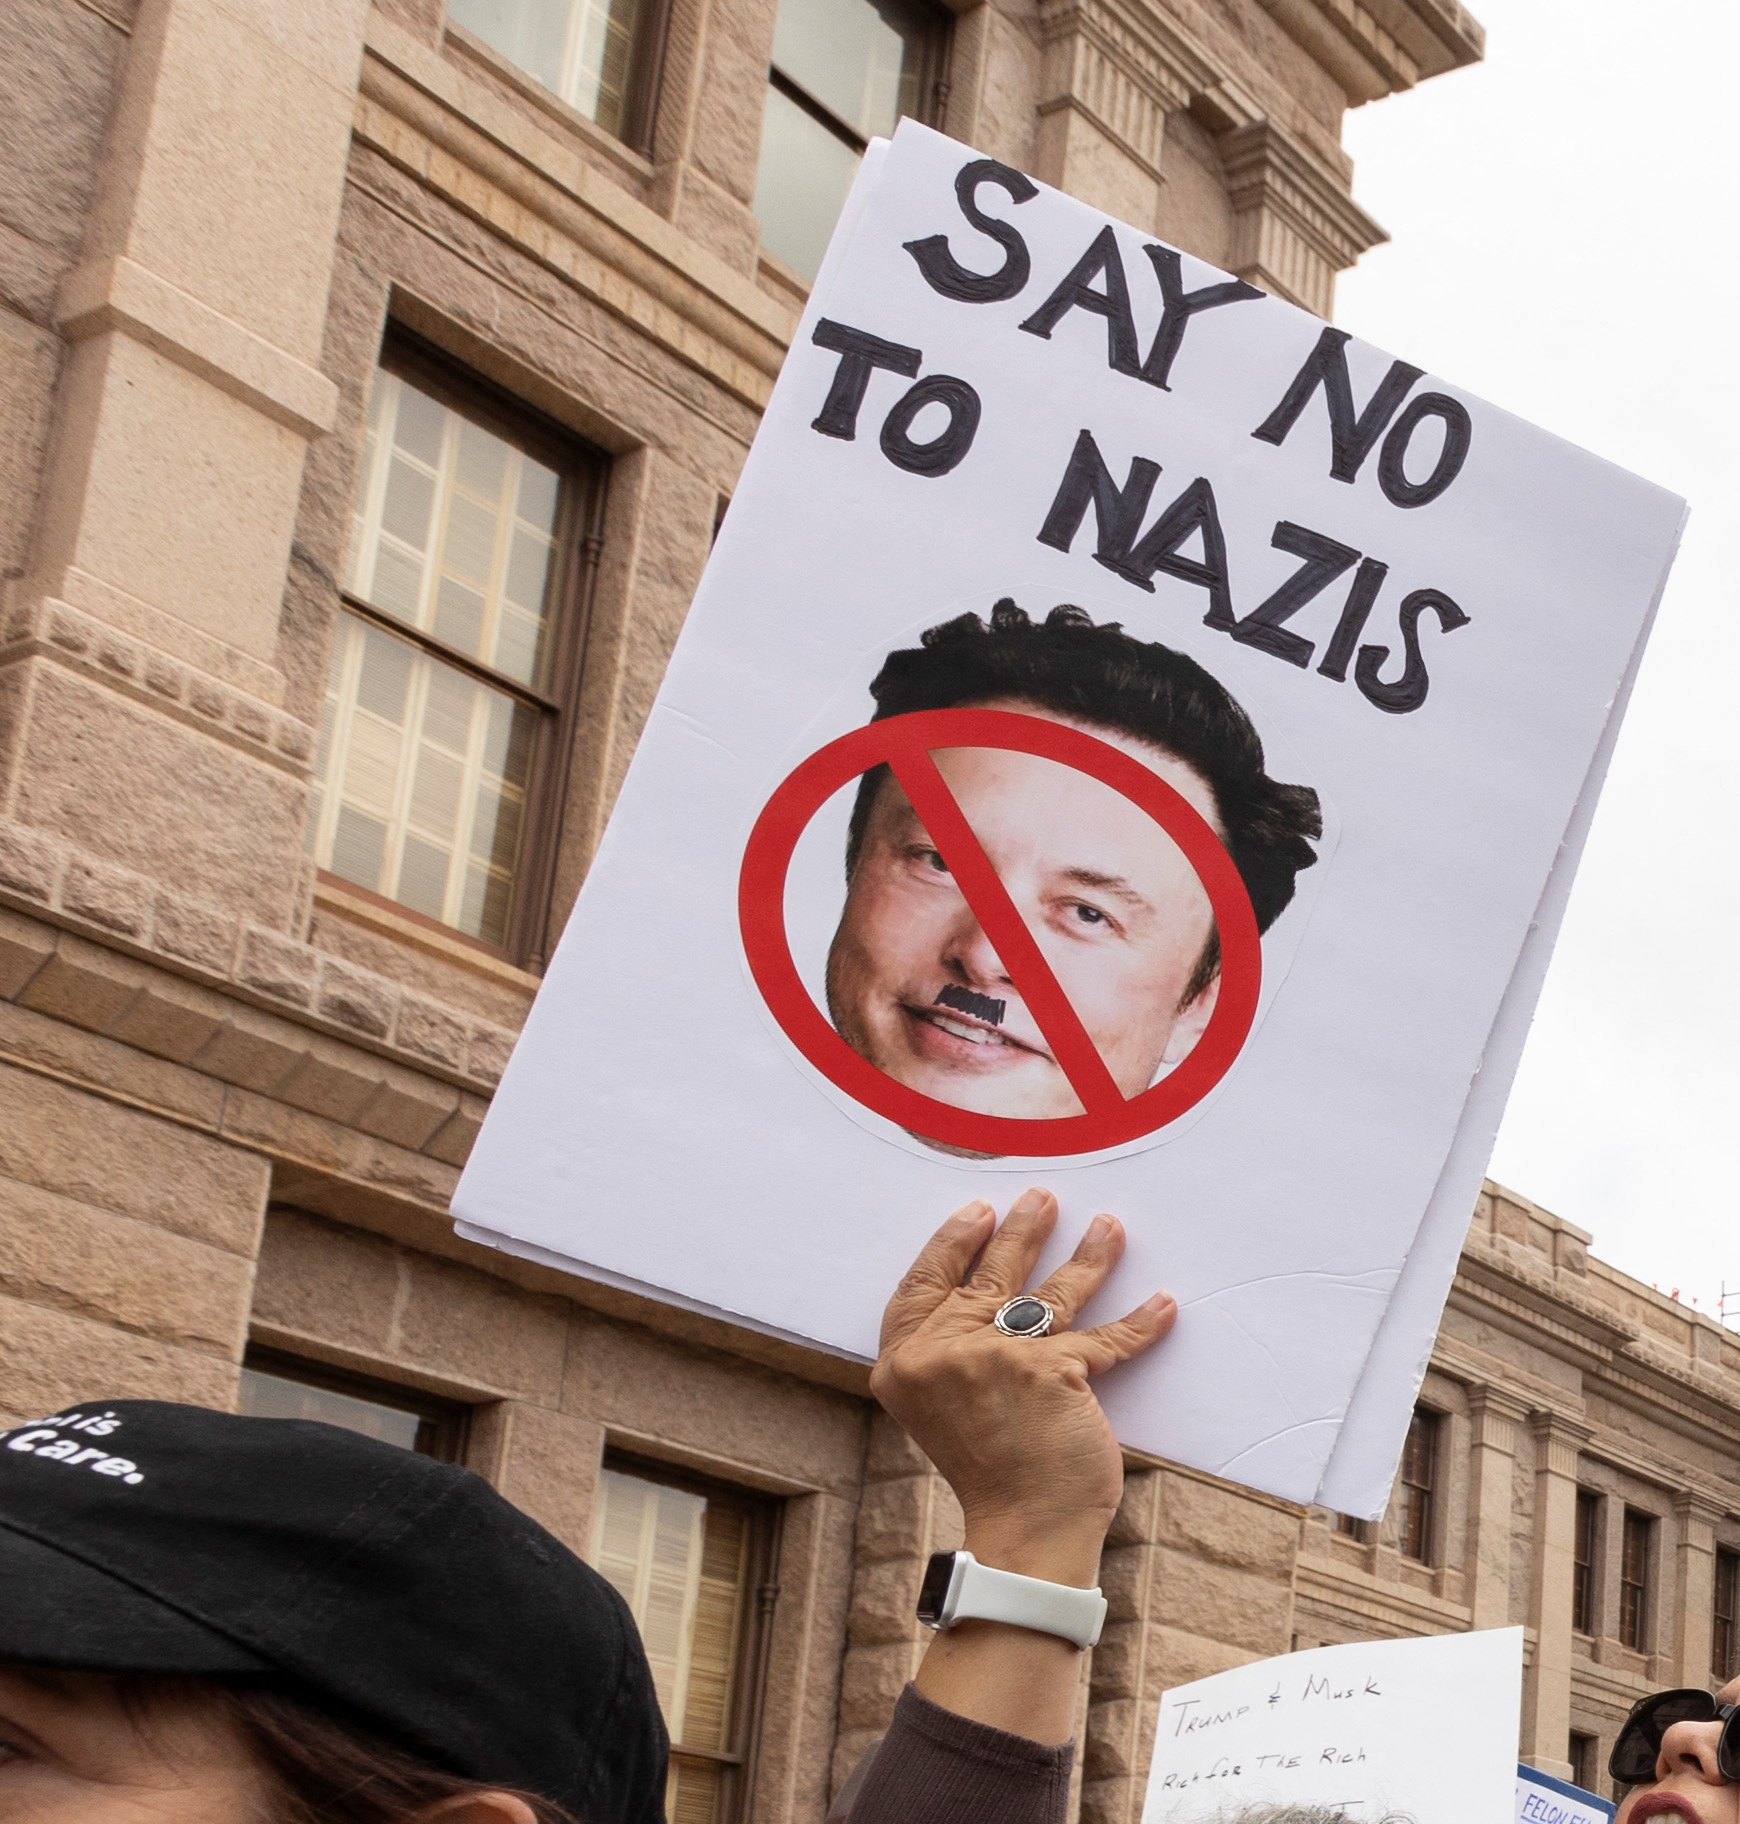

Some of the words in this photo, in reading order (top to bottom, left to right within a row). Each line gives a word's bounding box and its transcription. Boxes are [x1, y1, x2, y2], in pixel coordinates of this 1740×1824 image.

[902, 159, 1267, 391] SAY
[1251, 328, 1472, 508] NO
[810, 317, 982, 477] TO
[1036, 429, 1471, 716] NAZIS
[7, 1429, 144, 1485] Care.
[1268, 1682, 1281, 1710] &
